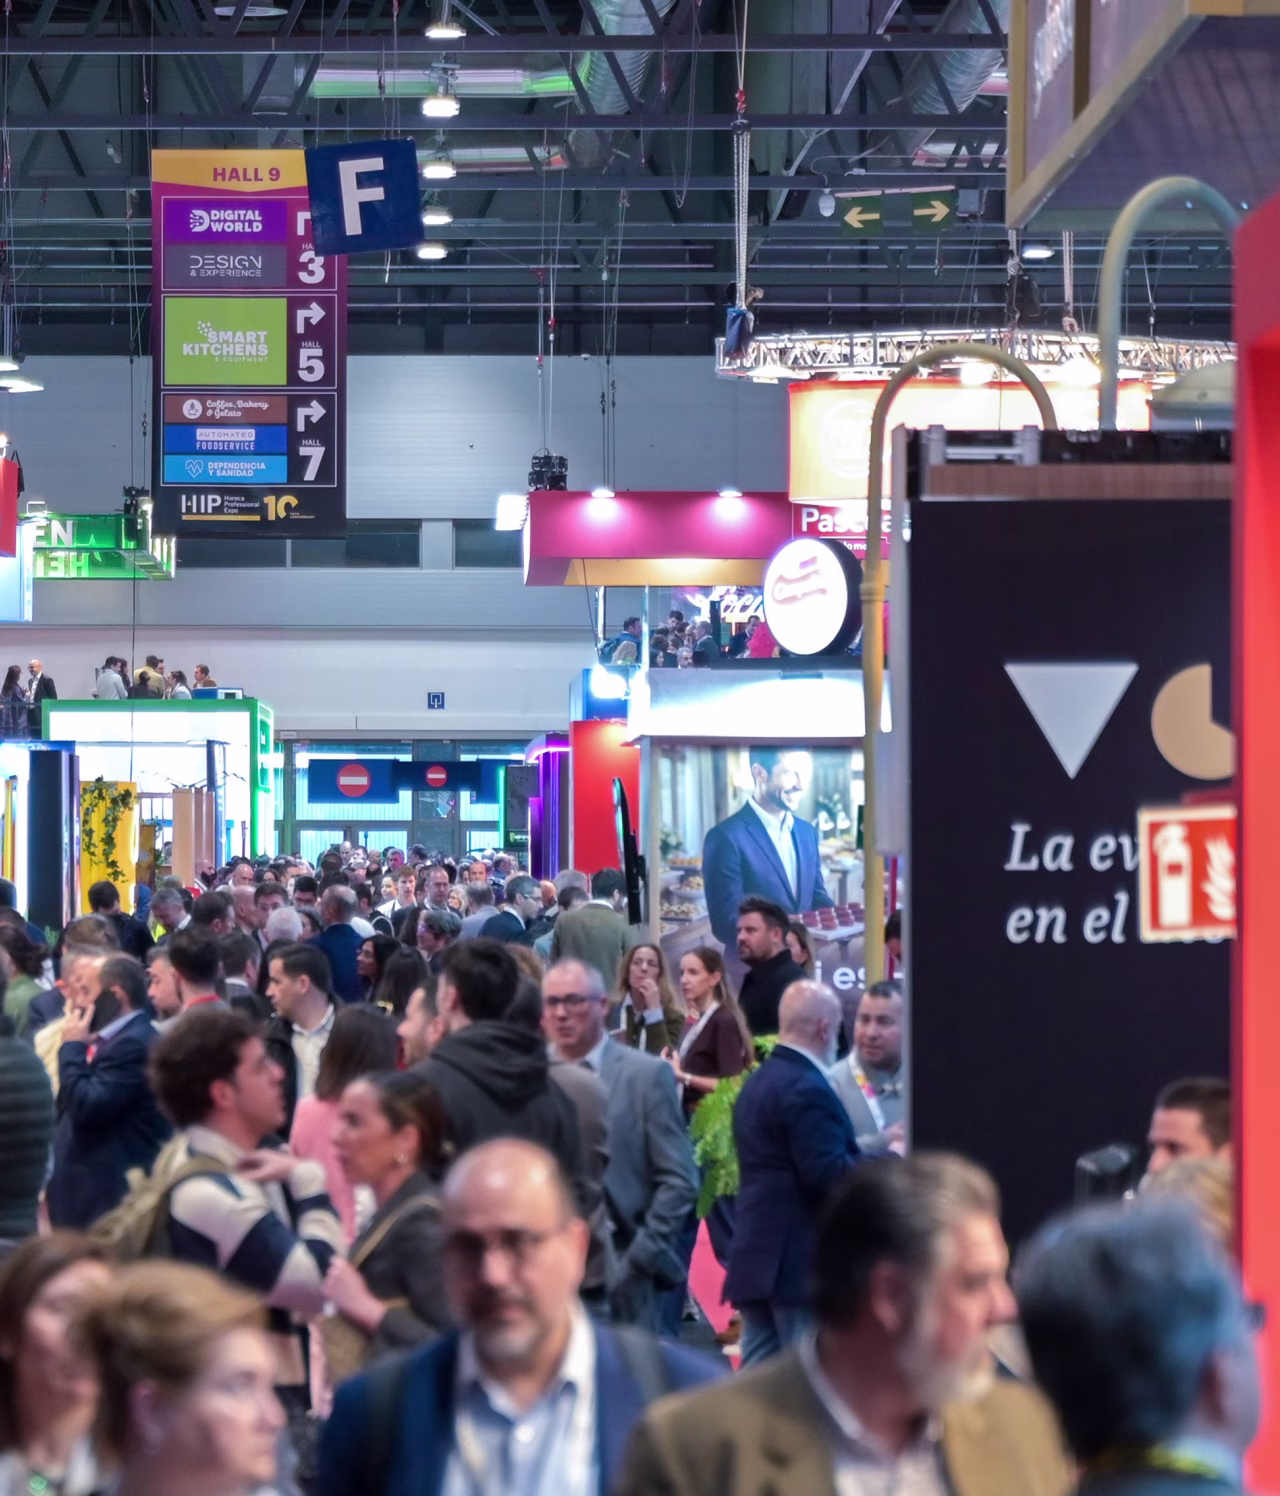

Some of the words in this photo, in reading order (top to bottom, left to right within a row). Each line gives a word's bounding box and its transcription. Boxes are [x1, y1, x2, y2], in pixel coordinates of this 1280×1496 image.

[213, 167, 263, 182] HALL
[268, 167, 281, 182] 9
[338, 157, 385, 236] F
[210, 209, 263, 221] DIGITAL
[210, 221, 263, 233] WORLD
[190, 255, 262, 269] DESIGN
[298, 251, 326, 284] 3
[200, 269, 262, 277] EXPERIENCE
[208, 331, 268, 344] SMART
[182, 343, 269, 356] KITCHENS
[297, 348, 325, 383] 5
[196, 441, 255, 450] FOODSERVICE
[208, 462, 266, 470] DEPENDENCIA
[299, 447, 326, 481] 7
[181, 494, 222, 514] HIP
[1003, 823, 1075, 872] La
[1005, 905, 1068, 944] en
[1082, 890, 1130, 944] el
